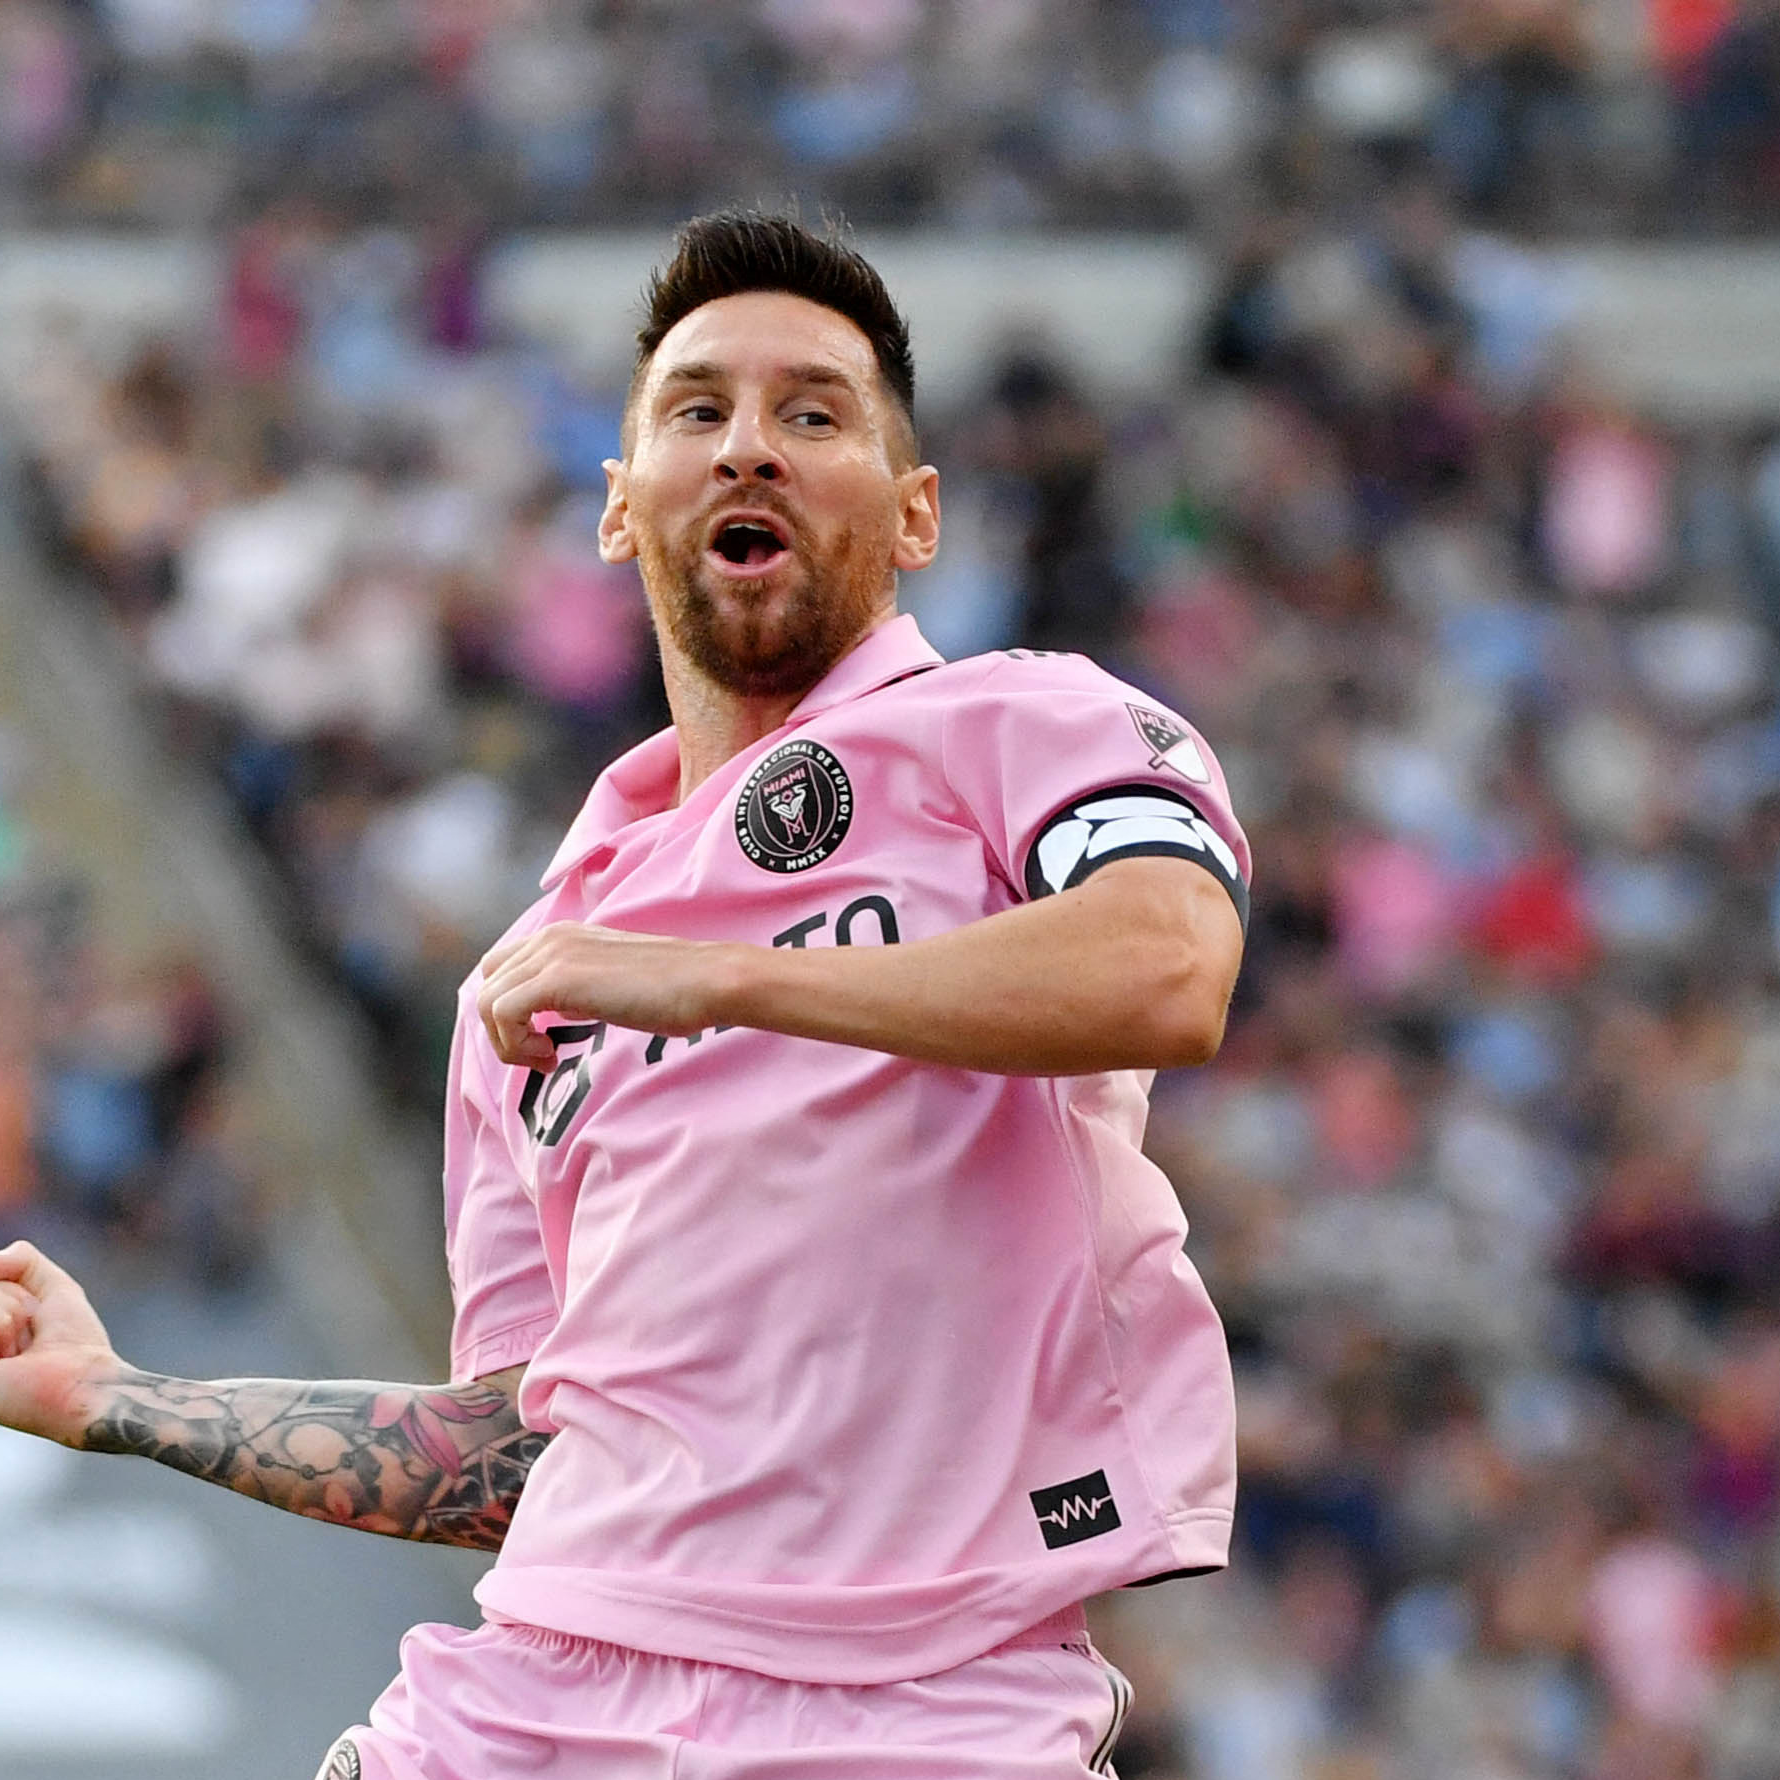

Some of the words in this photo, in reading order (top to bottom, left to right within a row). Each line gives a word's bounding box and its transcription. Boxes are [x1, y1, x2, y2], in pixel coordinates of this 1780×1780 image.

[816, 750, 833, 767] DE
[737, 743, 814, 822] INTERNACIONAL
[763, 767, 807, 797] MIAMI
[738, 827, 761, 860] CLUB
[786, 846, 827, 871] MMXX
